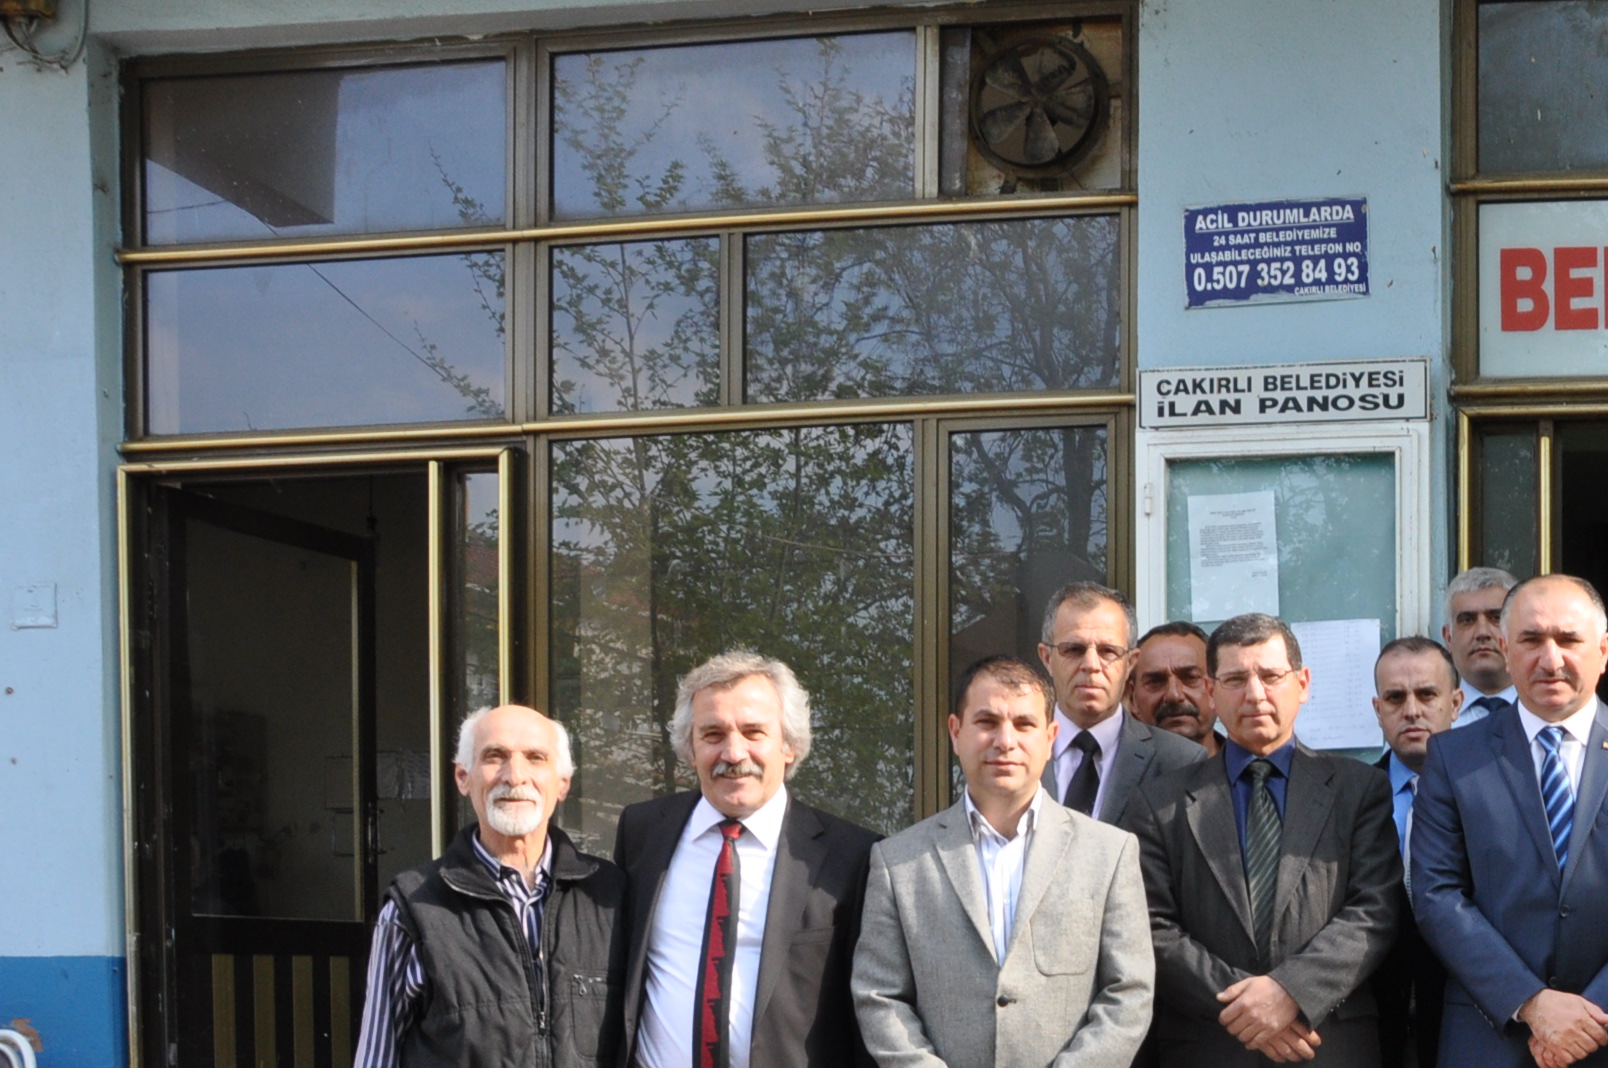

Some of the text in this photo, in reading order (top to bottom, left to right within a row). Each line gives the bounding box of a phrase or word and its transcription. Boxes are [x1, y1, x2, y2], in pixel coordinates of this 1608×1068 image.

[1195, 204, 1354, 230] ACİL DURUMLARDA
[1213, 226, 1337, 246] 24 SAAT BELEDİYEMİZE
[1294, 243, 1343, 256] TELEFON
[1346, 242, 1361, 252] NO
[1193, 257, 1359, 291] 0.507 352 84 93
[1258, 393, 1405, 414] PANOSU
